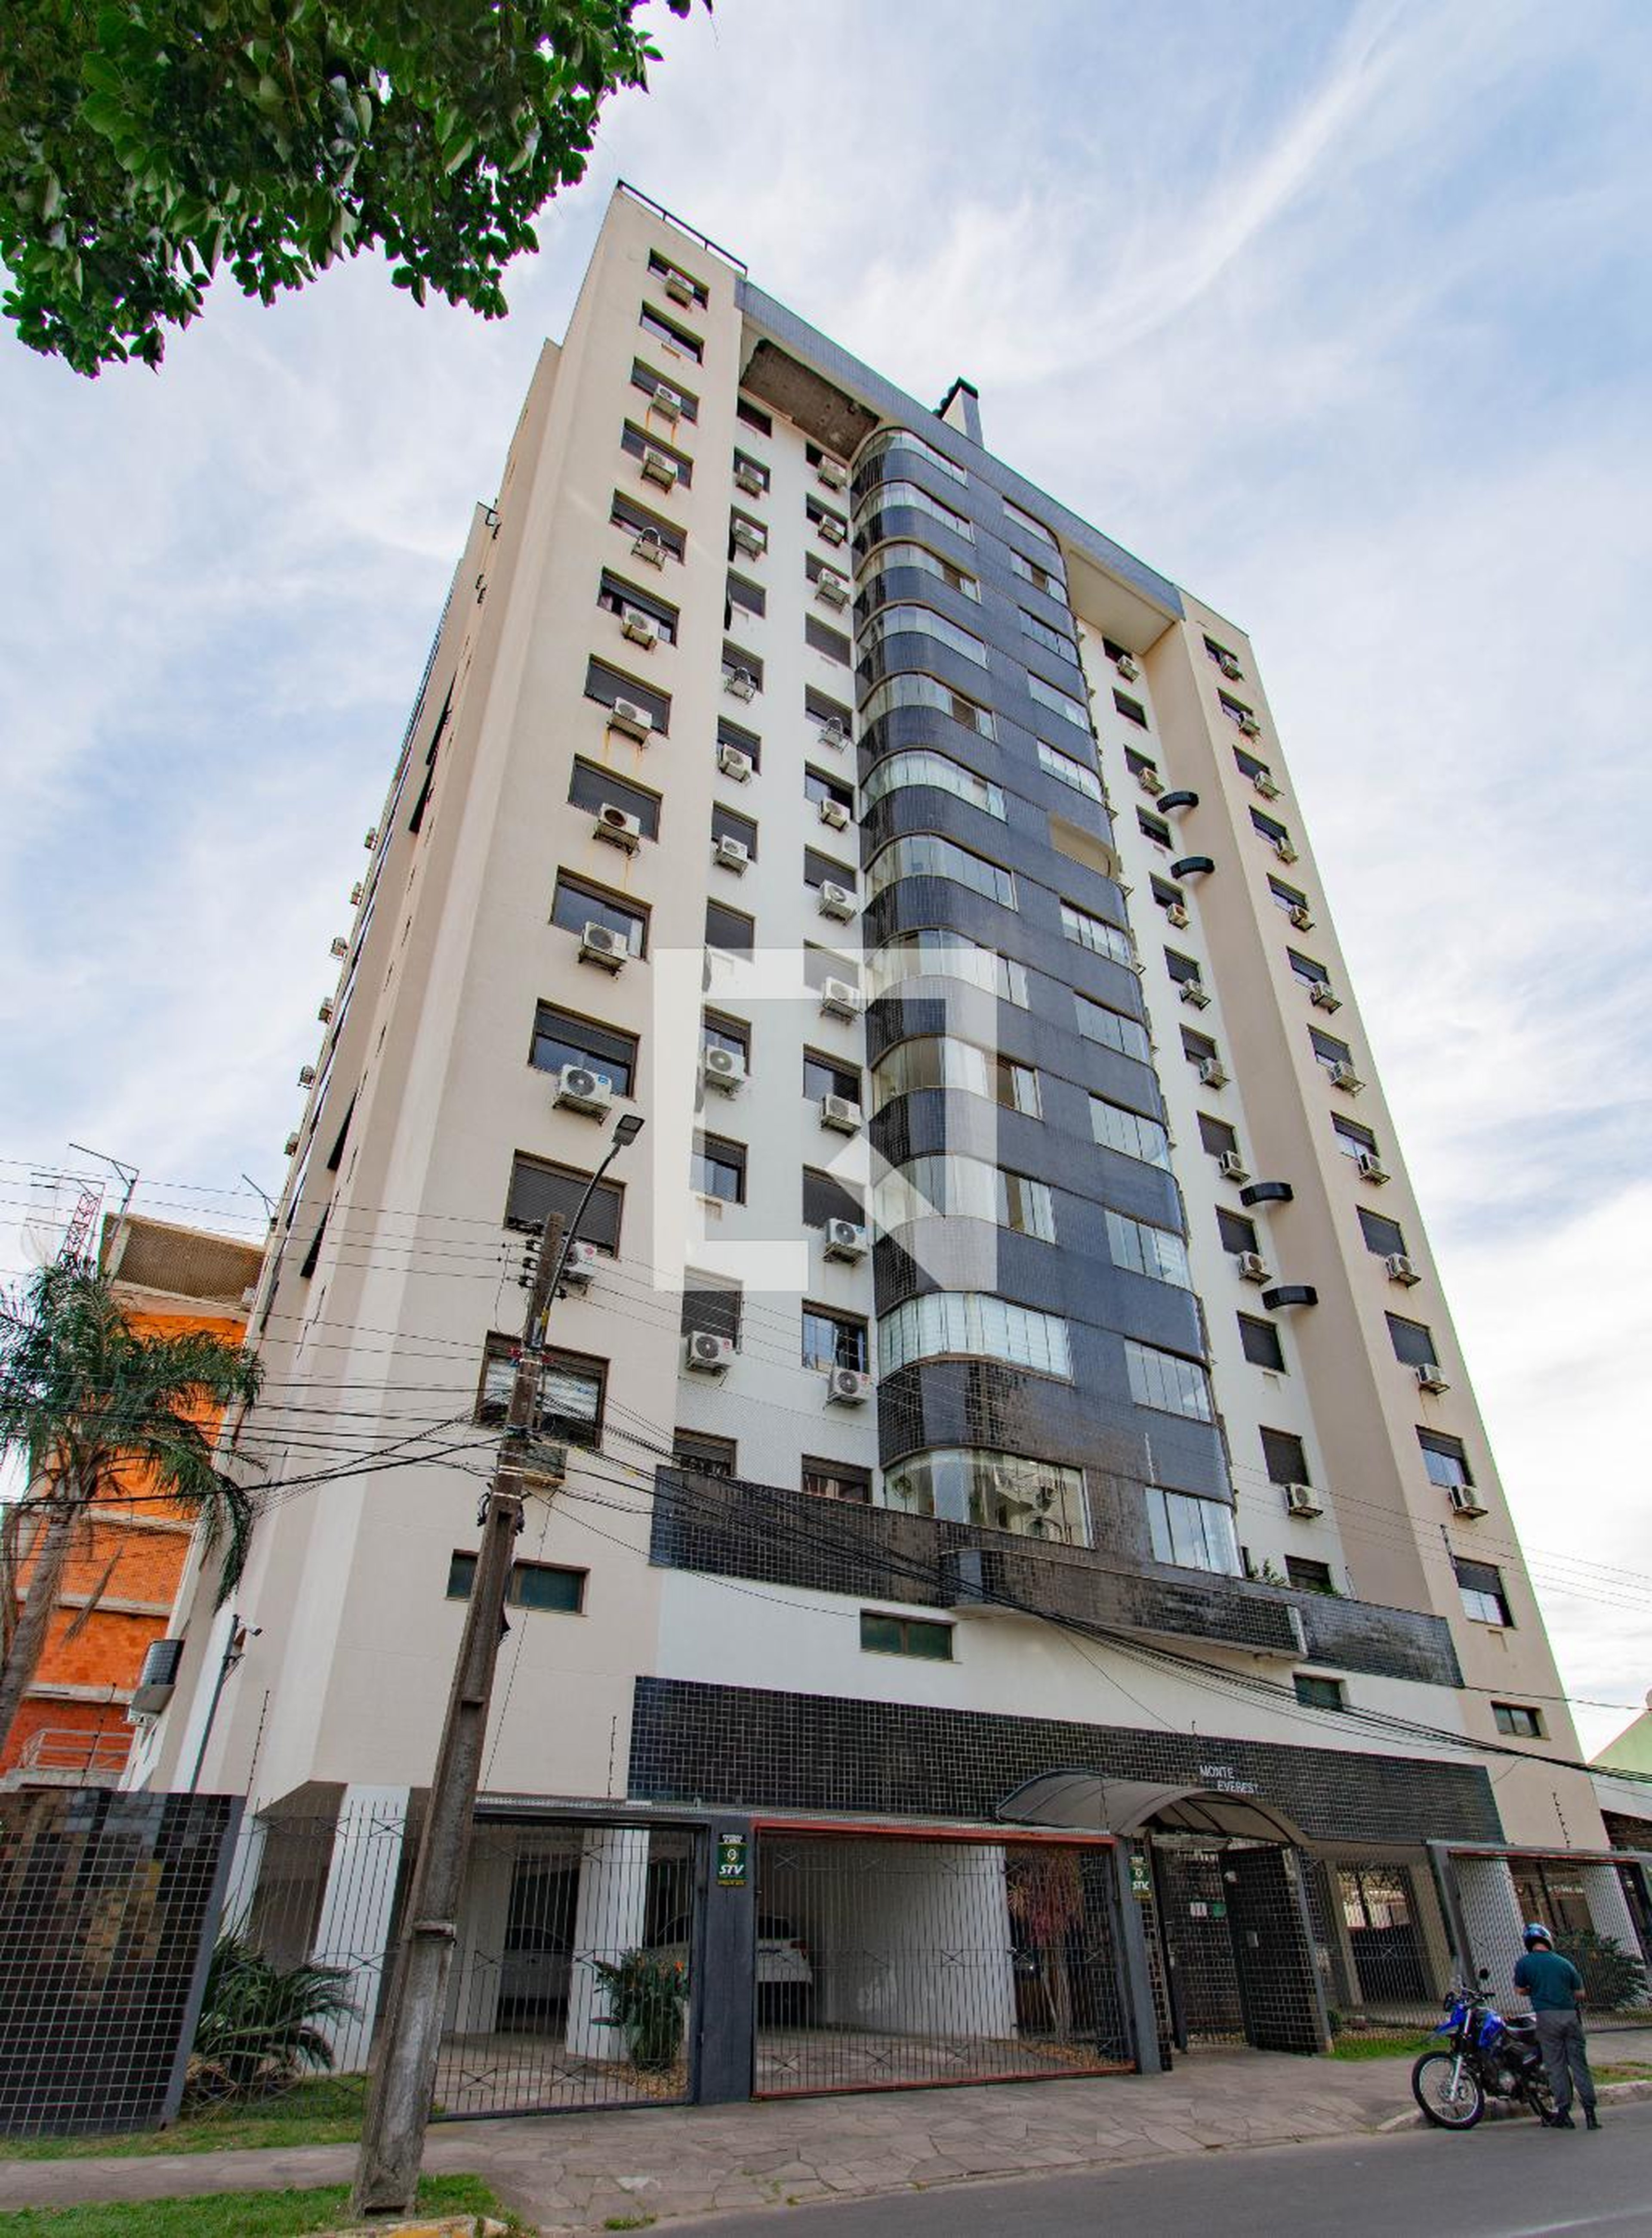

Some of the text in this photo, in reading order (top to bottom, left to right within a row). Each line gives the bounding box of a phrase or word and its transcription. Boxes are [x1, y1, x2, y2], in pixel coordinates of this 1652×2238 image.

[1199, 1765, 1235, 1779] MONTE
[1217, 1781, 1258, 1793] EVEREST
[719, 1864, 744, 1874] STV
